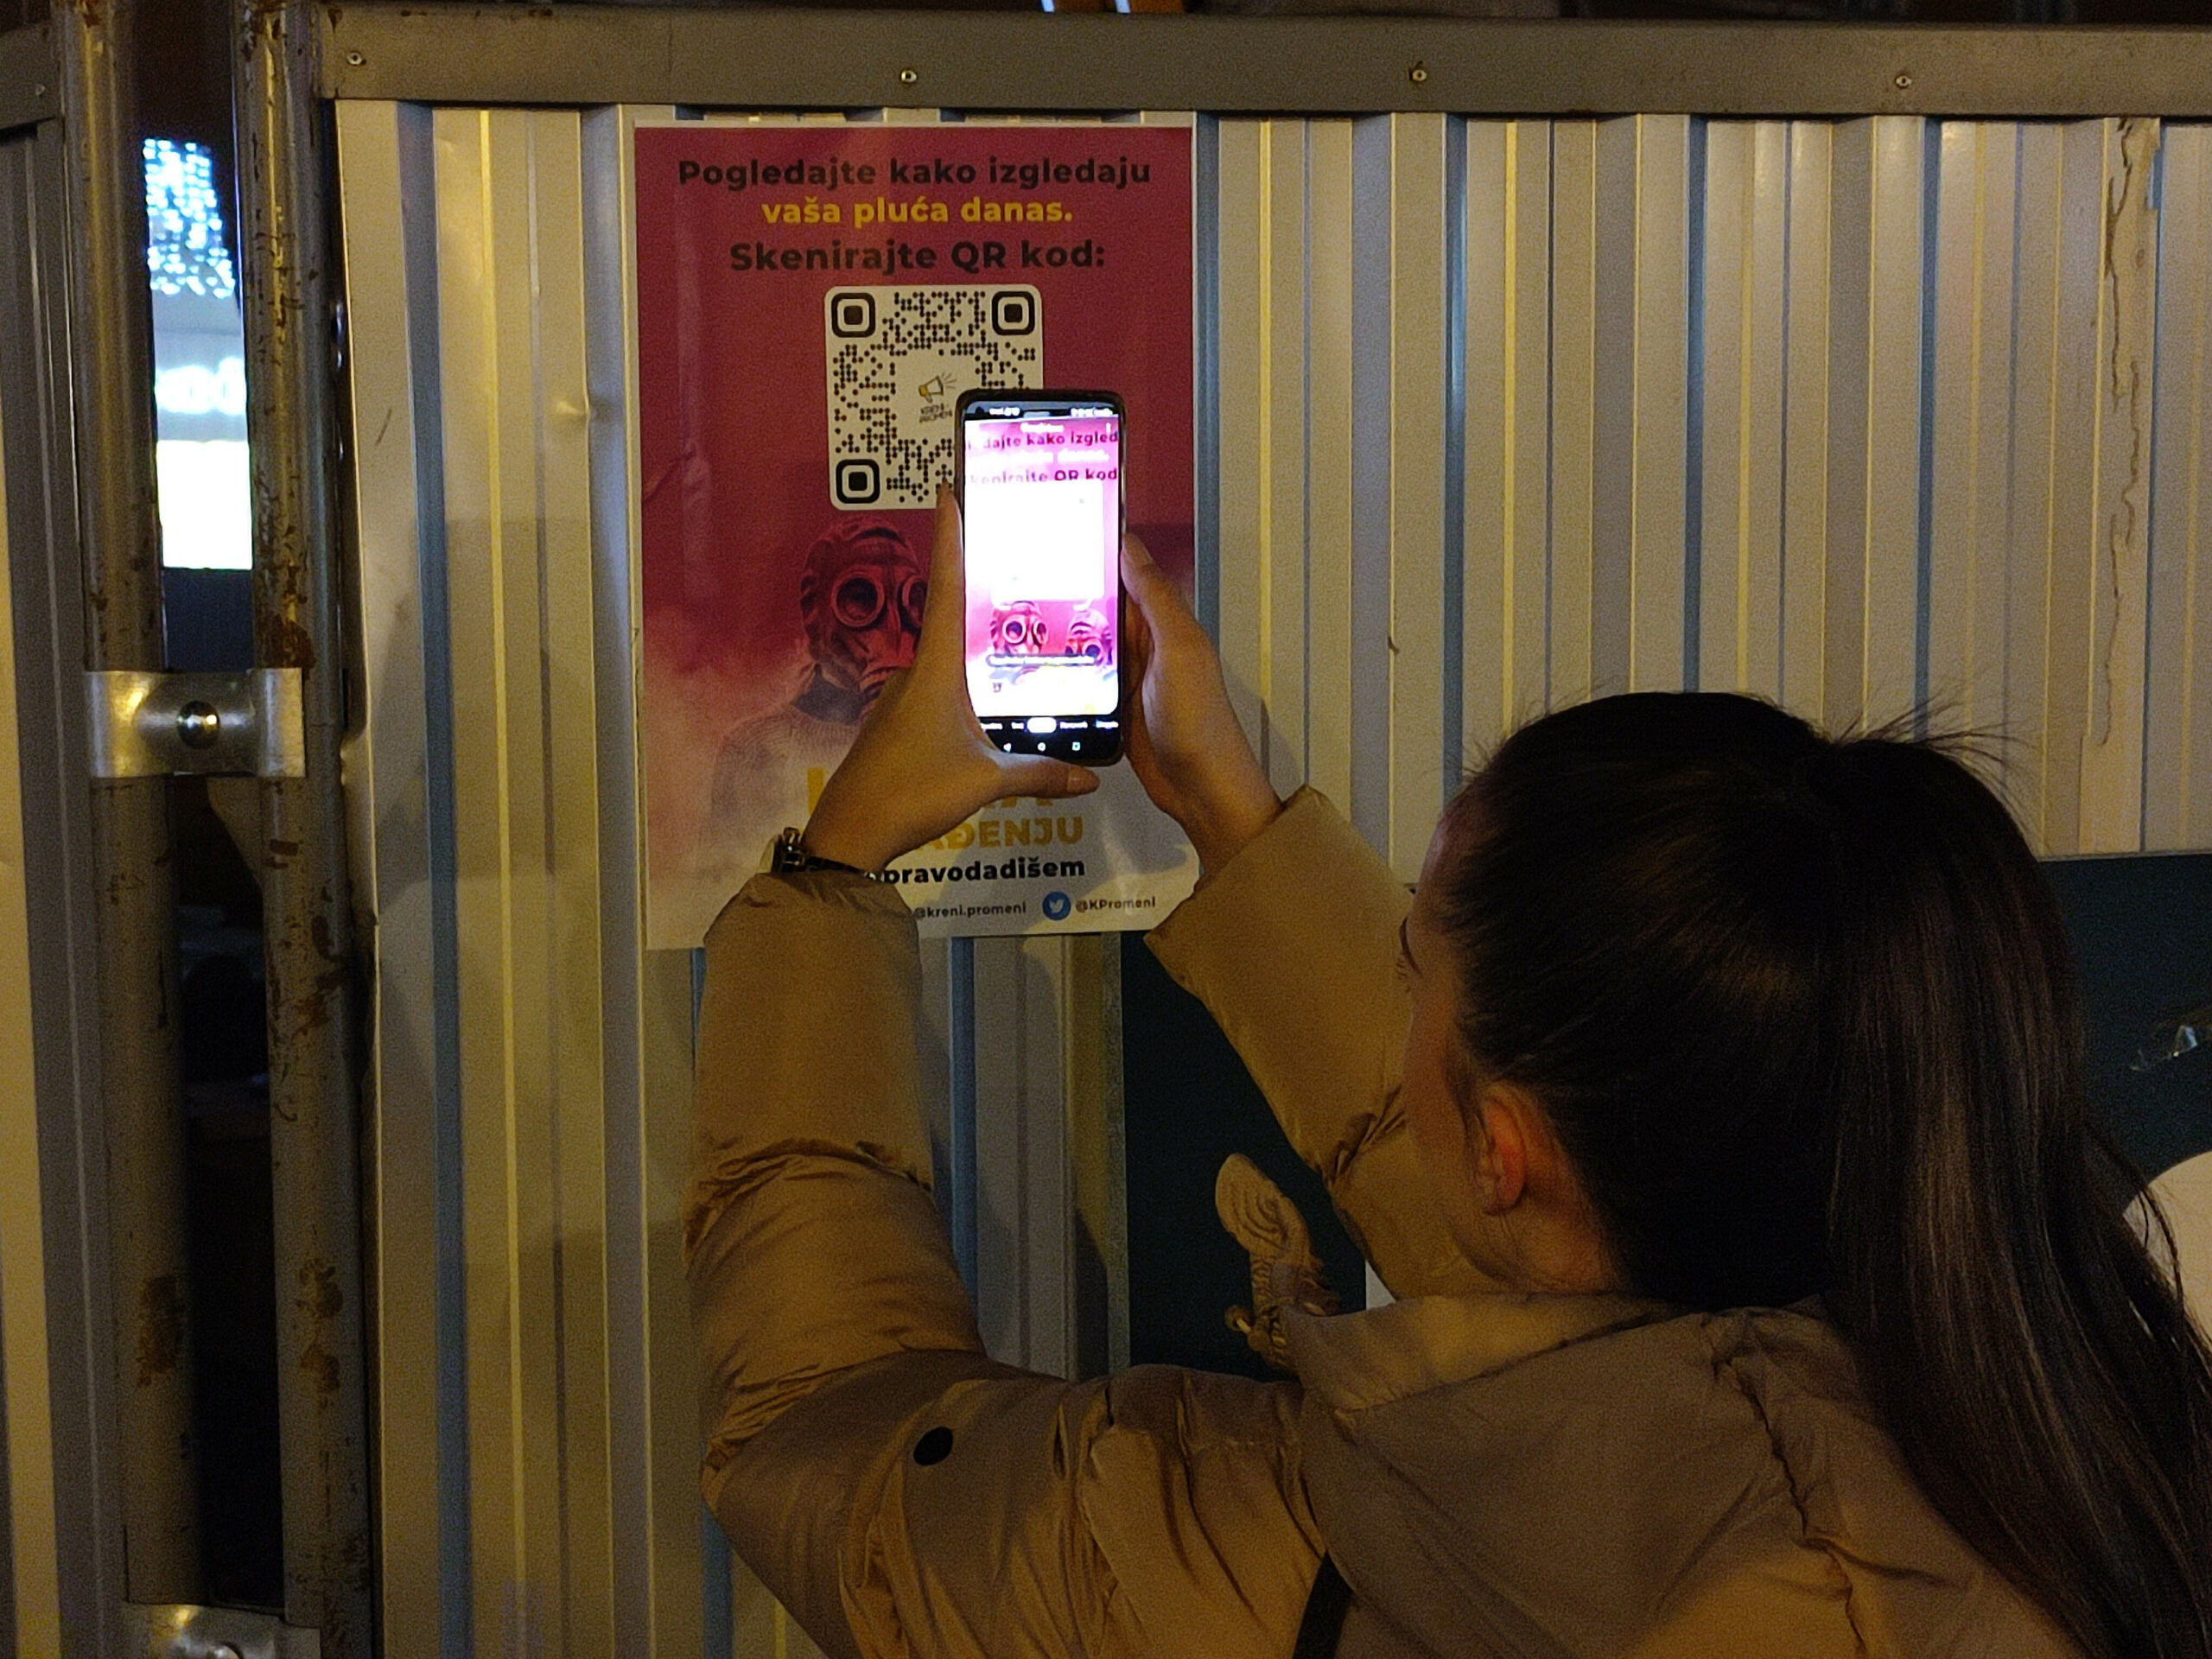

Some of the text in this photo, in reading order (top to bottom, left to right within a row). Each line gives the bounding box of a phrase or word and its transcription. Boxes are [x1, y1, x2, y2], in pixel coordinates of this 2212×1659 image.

[678, 156, 1151, 191] Pogledajte kako izgledaju
[761, 195, 1073, 229] vaša pluća danas.
[730, 238, 1105, 276] Skenirajte QR kod:
[1027, 432, 1065, 446] kako
[1071, 430, 1119, 447] izgled
[1085, 467, 1118, 481] kod
[883, 855, 1085, 885] pravodadišem
[913, 900, 1027, 920] @kreni.promeni
[1075, 896, 1156, 913] @KPromeni
